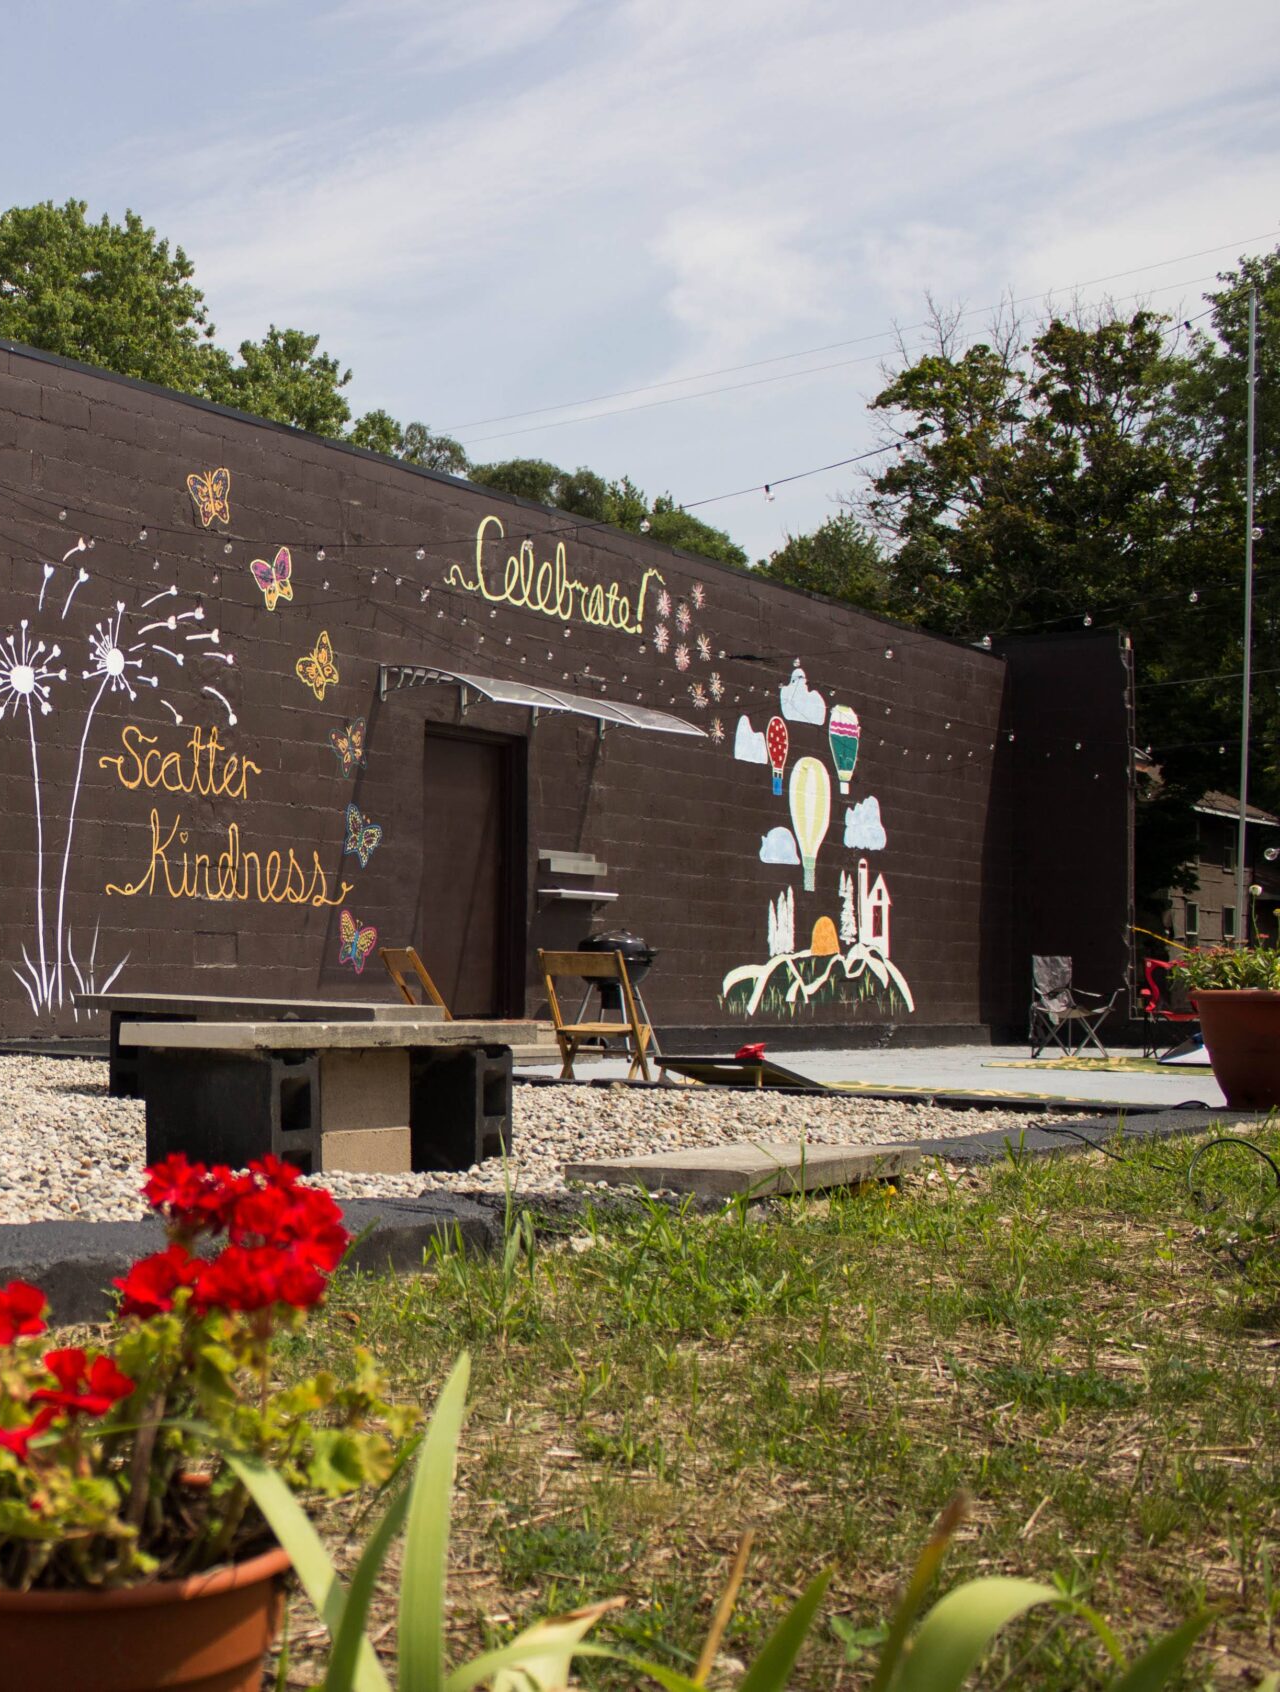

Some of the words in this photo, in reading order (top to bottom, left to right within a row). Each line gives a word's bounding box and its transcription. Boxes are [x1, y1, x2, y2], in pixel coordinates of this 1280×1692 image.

[443, 515, 666, 634] Celebrate!
[99, 726, 262, 799] Scatter
[106, 808, 354, 906] Kindness
